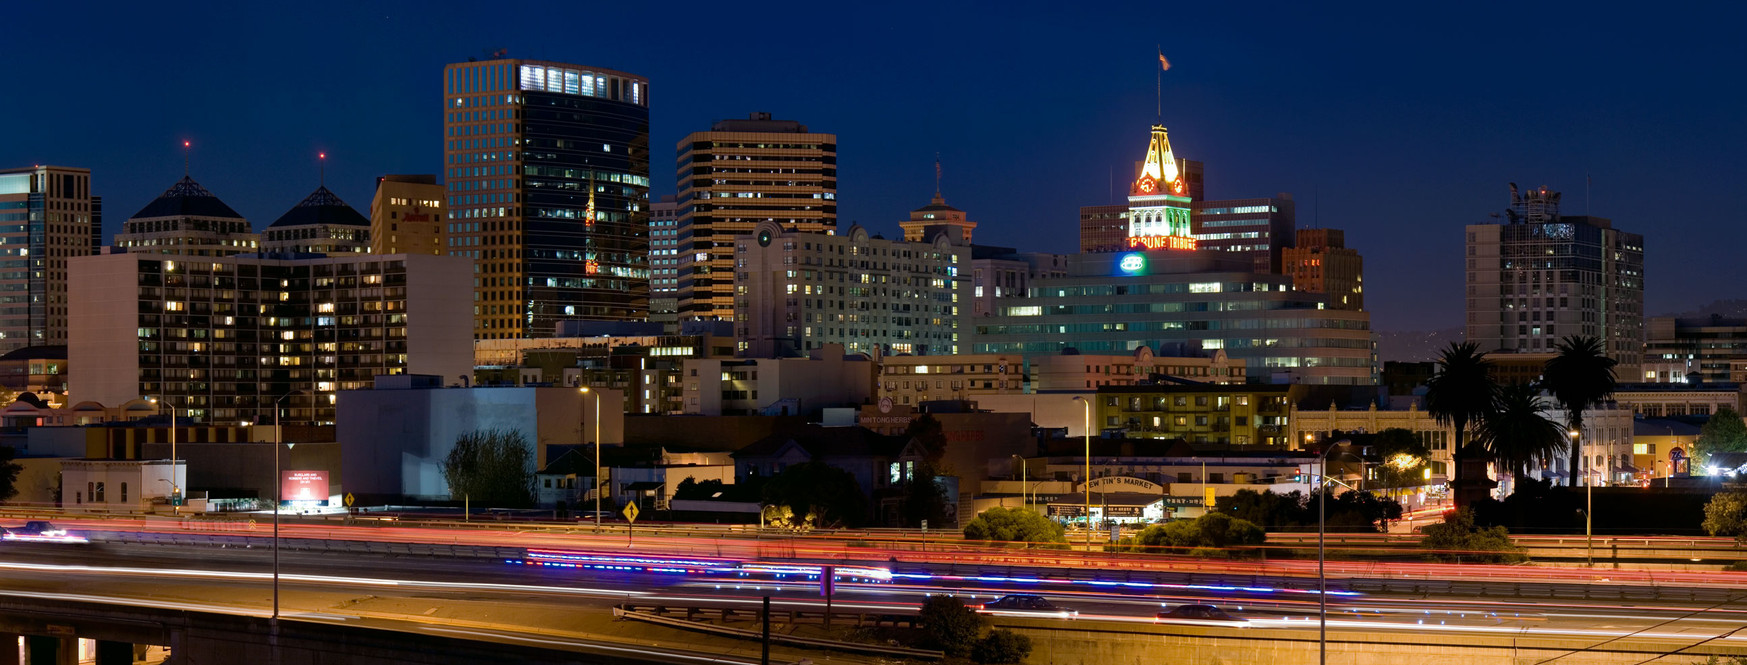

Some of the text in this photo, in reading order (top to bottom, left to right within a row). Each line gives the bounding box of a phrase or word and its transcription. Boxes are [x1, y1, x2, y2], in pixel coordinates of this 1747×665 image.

[891, 416, 912, 424] HERBS
[1670, 450, 1683, 460] 76
[1124, 478, 1153, 490] MARKET
